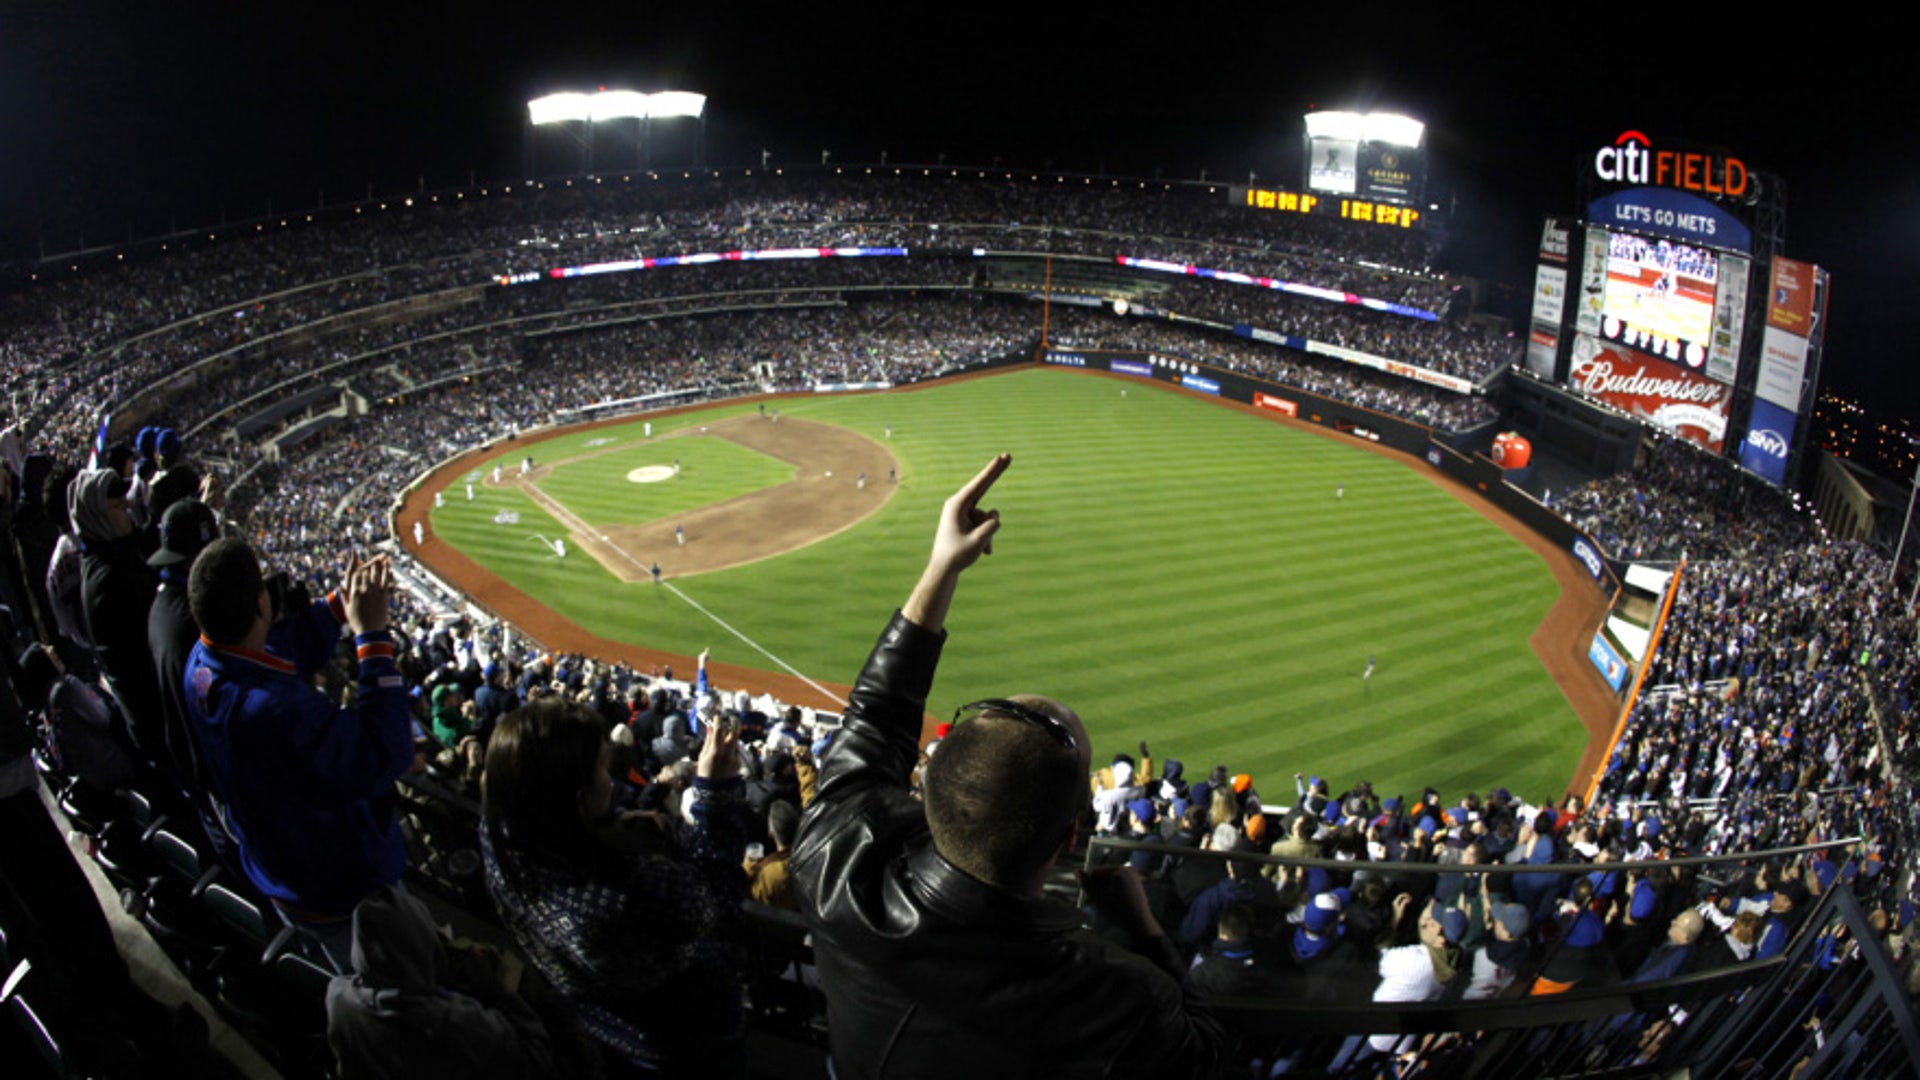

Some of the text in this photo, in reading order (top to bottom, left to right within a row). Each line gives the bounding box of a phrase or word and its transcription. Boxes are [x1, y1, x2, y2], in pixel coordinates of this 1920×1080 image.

[1595, 139, 1748, 196] citi FIELD
[1616, 204, 1717, 235] LET'S GO METS
[1054, 354, 1086, 366] DELTA
[1579, 360, 1722, 402] Budweiser
[1748, 429, 1783, 457] SNY
[1574, 540, 1601, 577] GEICO
